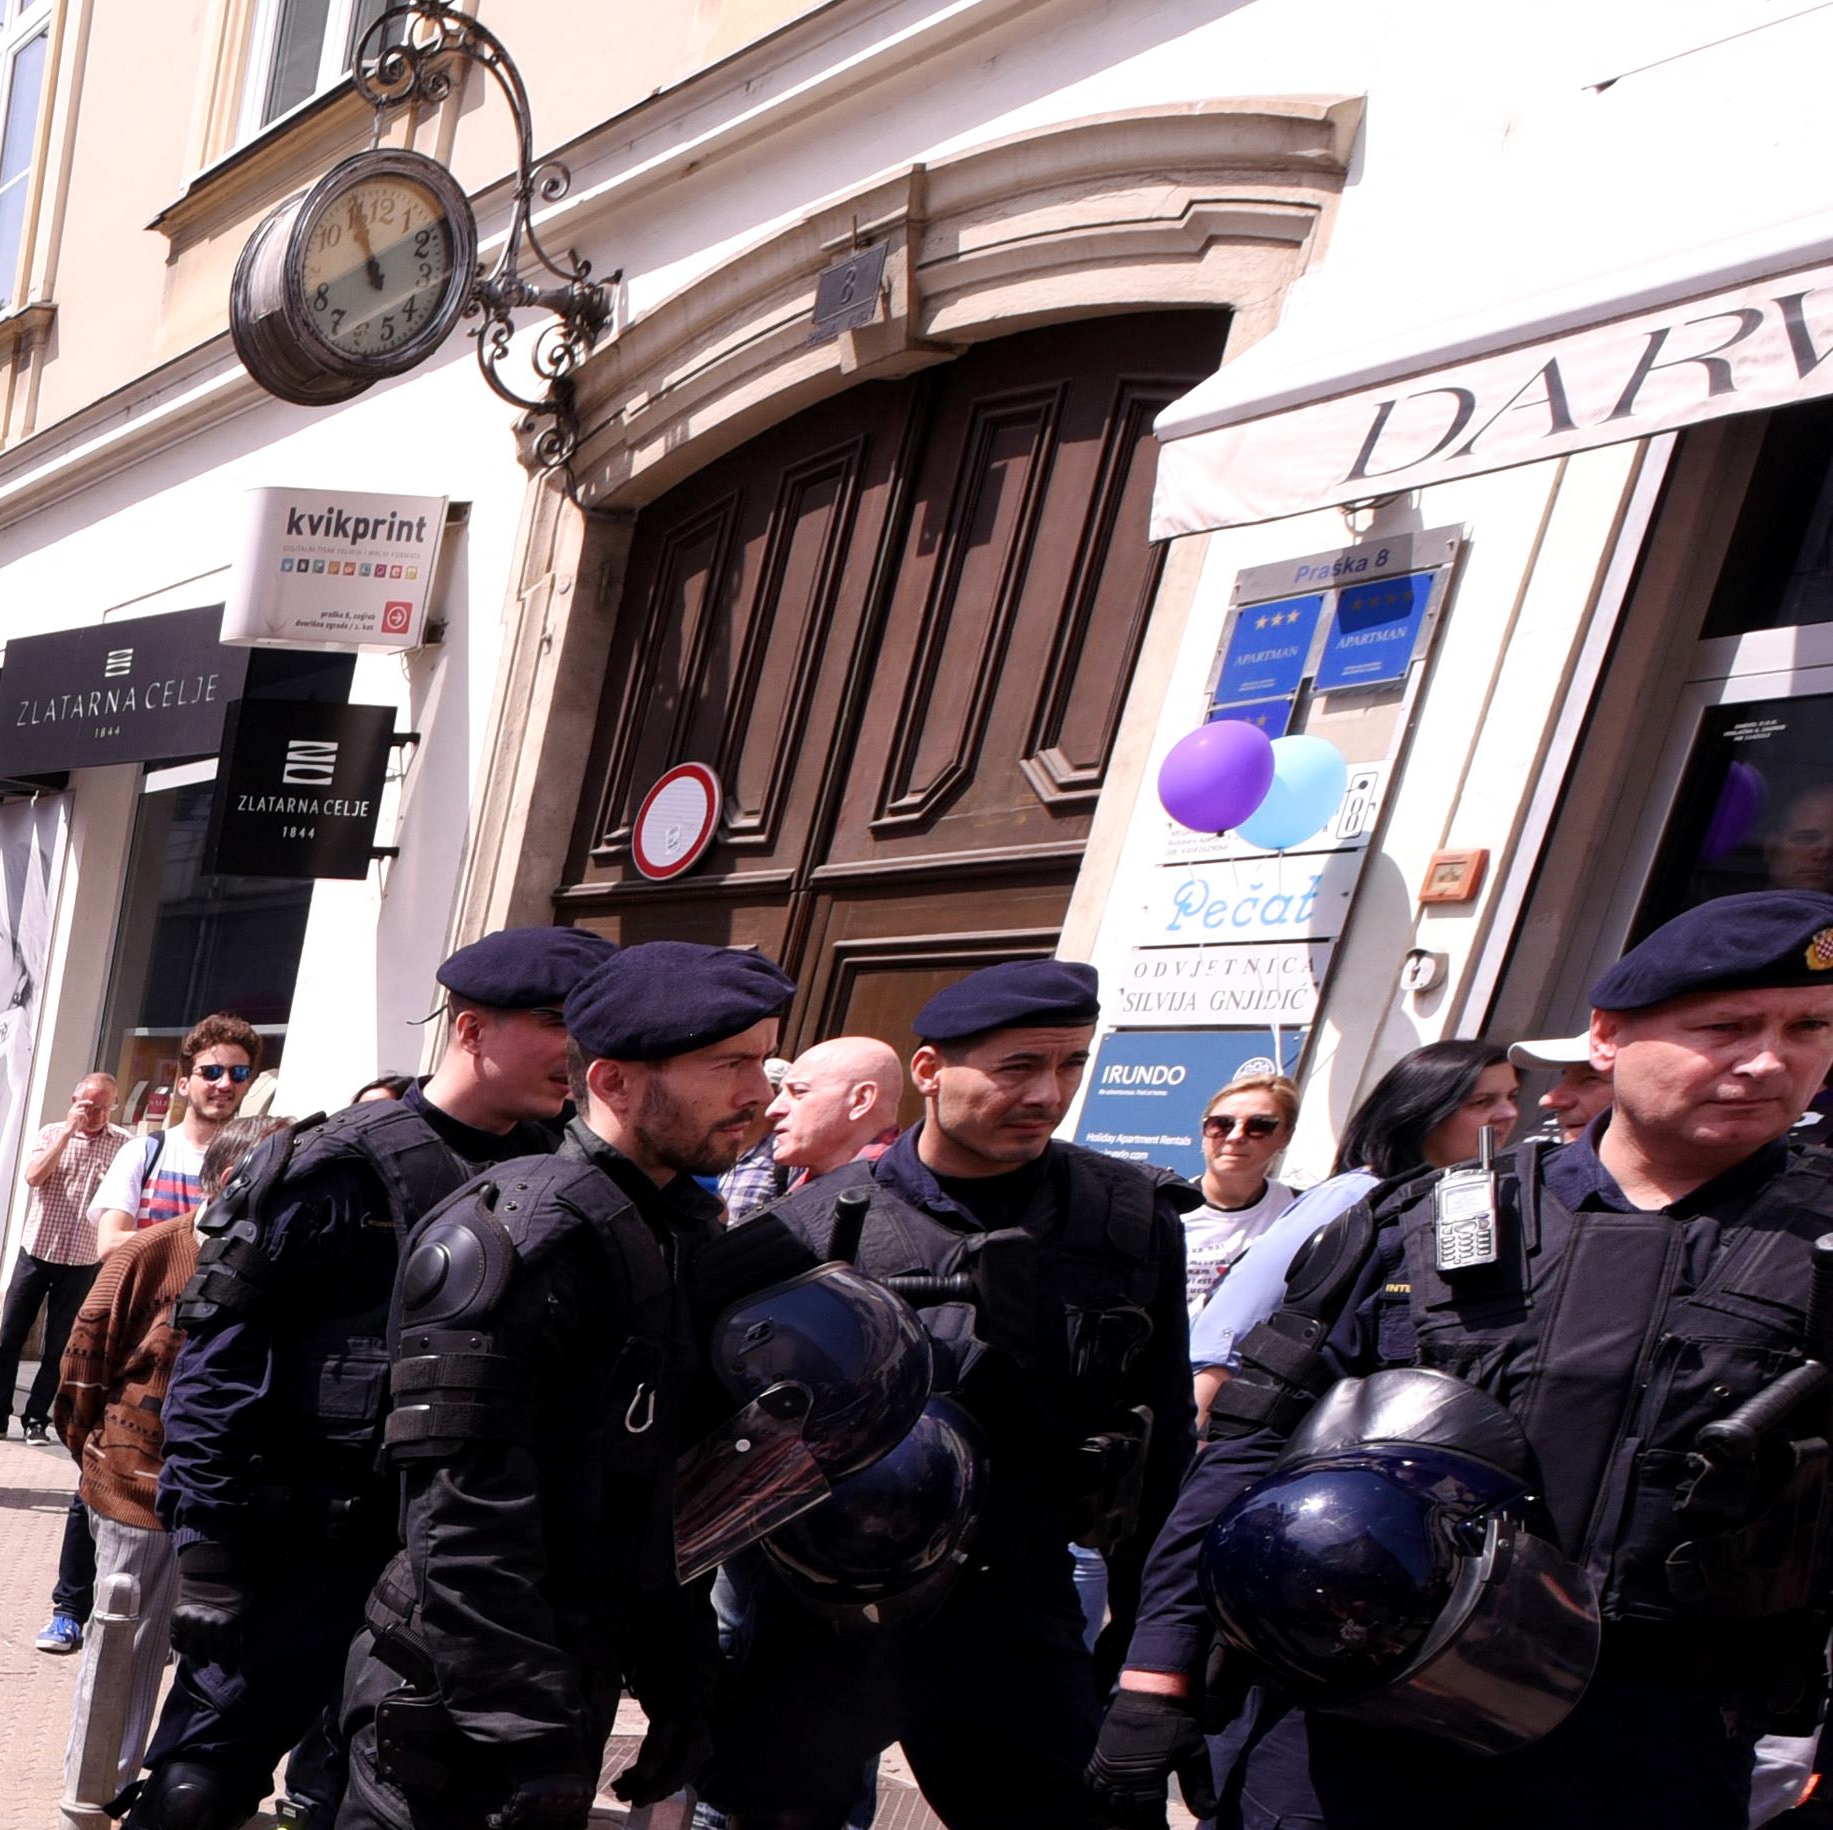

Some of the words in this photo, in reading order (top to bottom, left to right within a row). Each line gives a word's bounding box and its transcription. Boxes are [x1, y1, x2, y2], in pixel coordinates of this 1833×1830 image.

[413, 229, 431, 259] 2
[415, 262, 432, 288] 3
[313, 282, 330, 312] 8
[401, 294, 418, 323] 4
[330, 308, 347, 336] 7
[380, 315, 395, 341] 5
[286, 506, 427, 546] kvikprint
[1292, 555, 1369, 584] Praška
[1373, 547, 1391, 568] 8
[1335, 626, 1408, 650] APARTMAN
[1233, 645, 1300, 667] APARTMAN
[16, 687, 137, 727] ZLATARNA
[144, 673, 220, 711] CELJE
[94, 725, 121, 739] 1844
[237, 795, 320, 815] ZLATARNA
[323, 799, 371, 817] CELJE
[282, 825, 316, 839] 1844
[1164, 873, 1324, 932] Pečat
[1122, 990, 1198, 1013] SILVIJA
[1100, 1064, 1187, 1086] IRUNDO
[1086, 1131, 1116, 1146] Holiday
[1117, 1132, 1159, 1146] Apartment
[1160, 1134, 1193, 1147] Rentals
